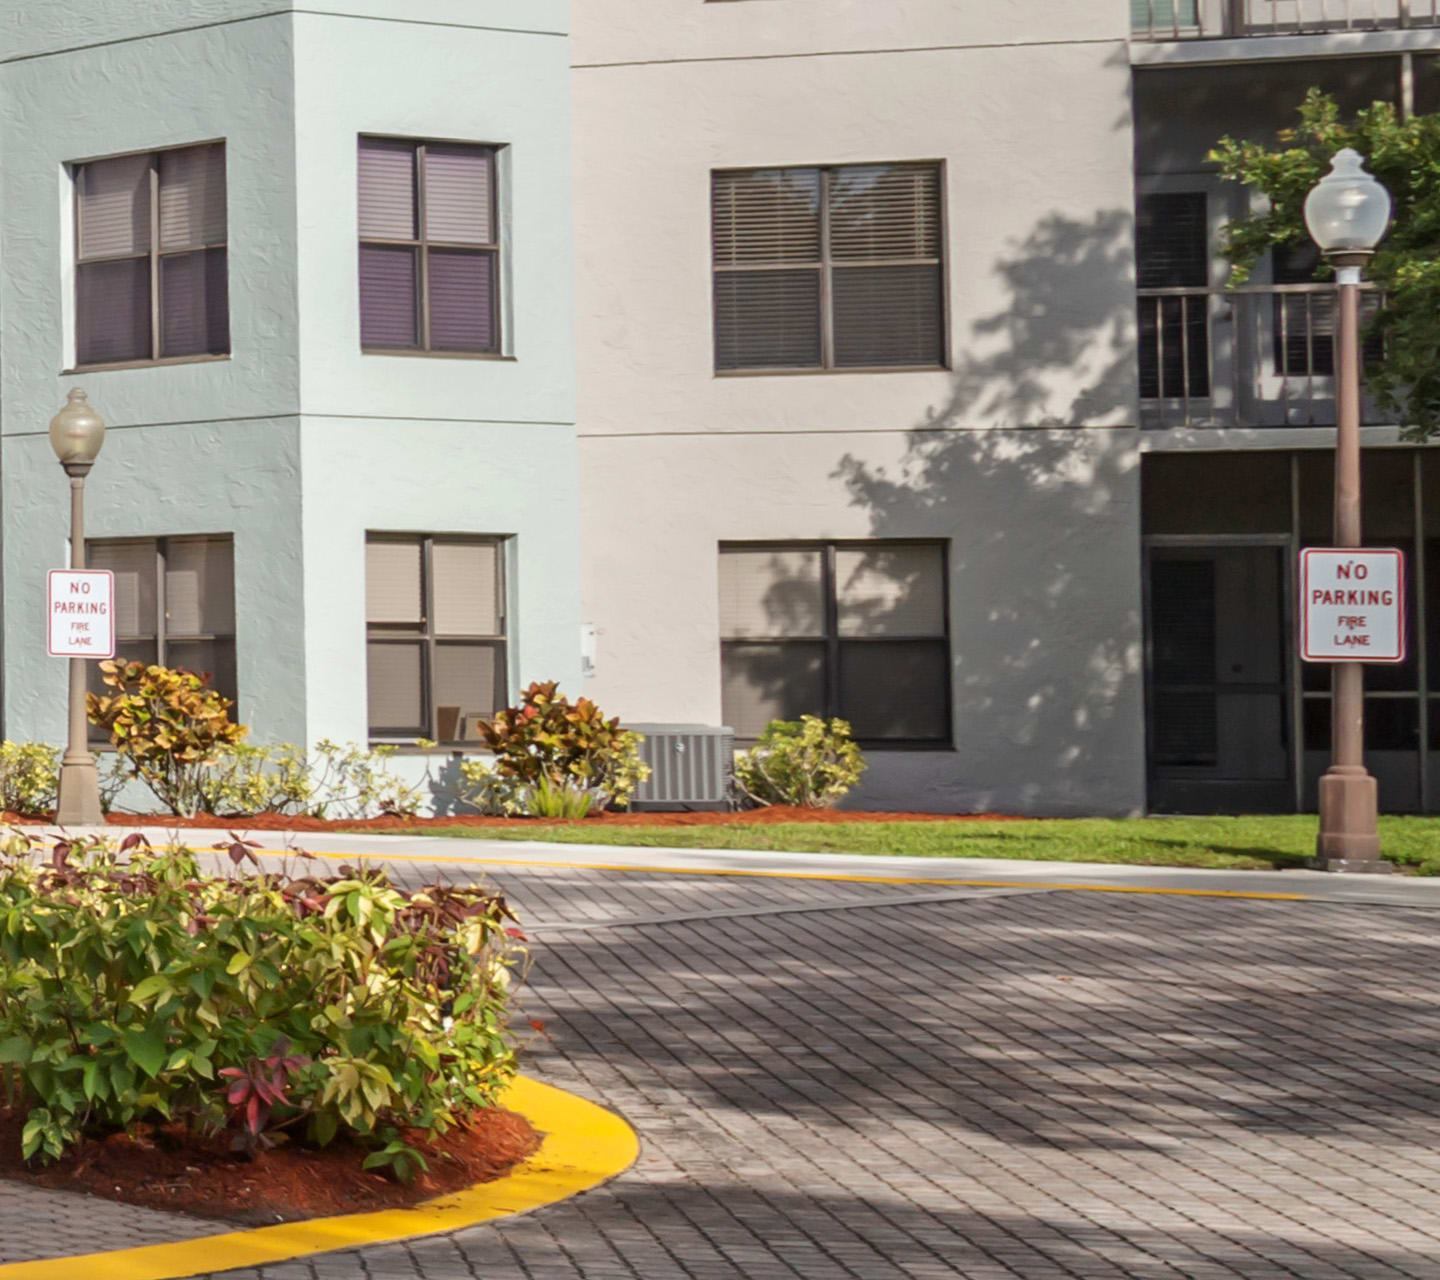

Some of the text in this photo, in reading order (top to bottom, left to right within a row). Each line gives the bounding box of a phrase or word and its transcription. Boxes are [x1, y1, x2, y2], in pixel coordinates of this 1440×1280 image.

[1336, 563, 1368, 580] NO
[70, 582, 91, 594] NO
[1312, 589, 1393, 606] PARKING
[54, 601, 107, 615] PARKING
[70, 622, 90, 631] FIRE
[1337, 615, 1367, 627] FIRE
[68, 637, 92, 646] LANE
[1334, 634, 1370, 646] LANE
